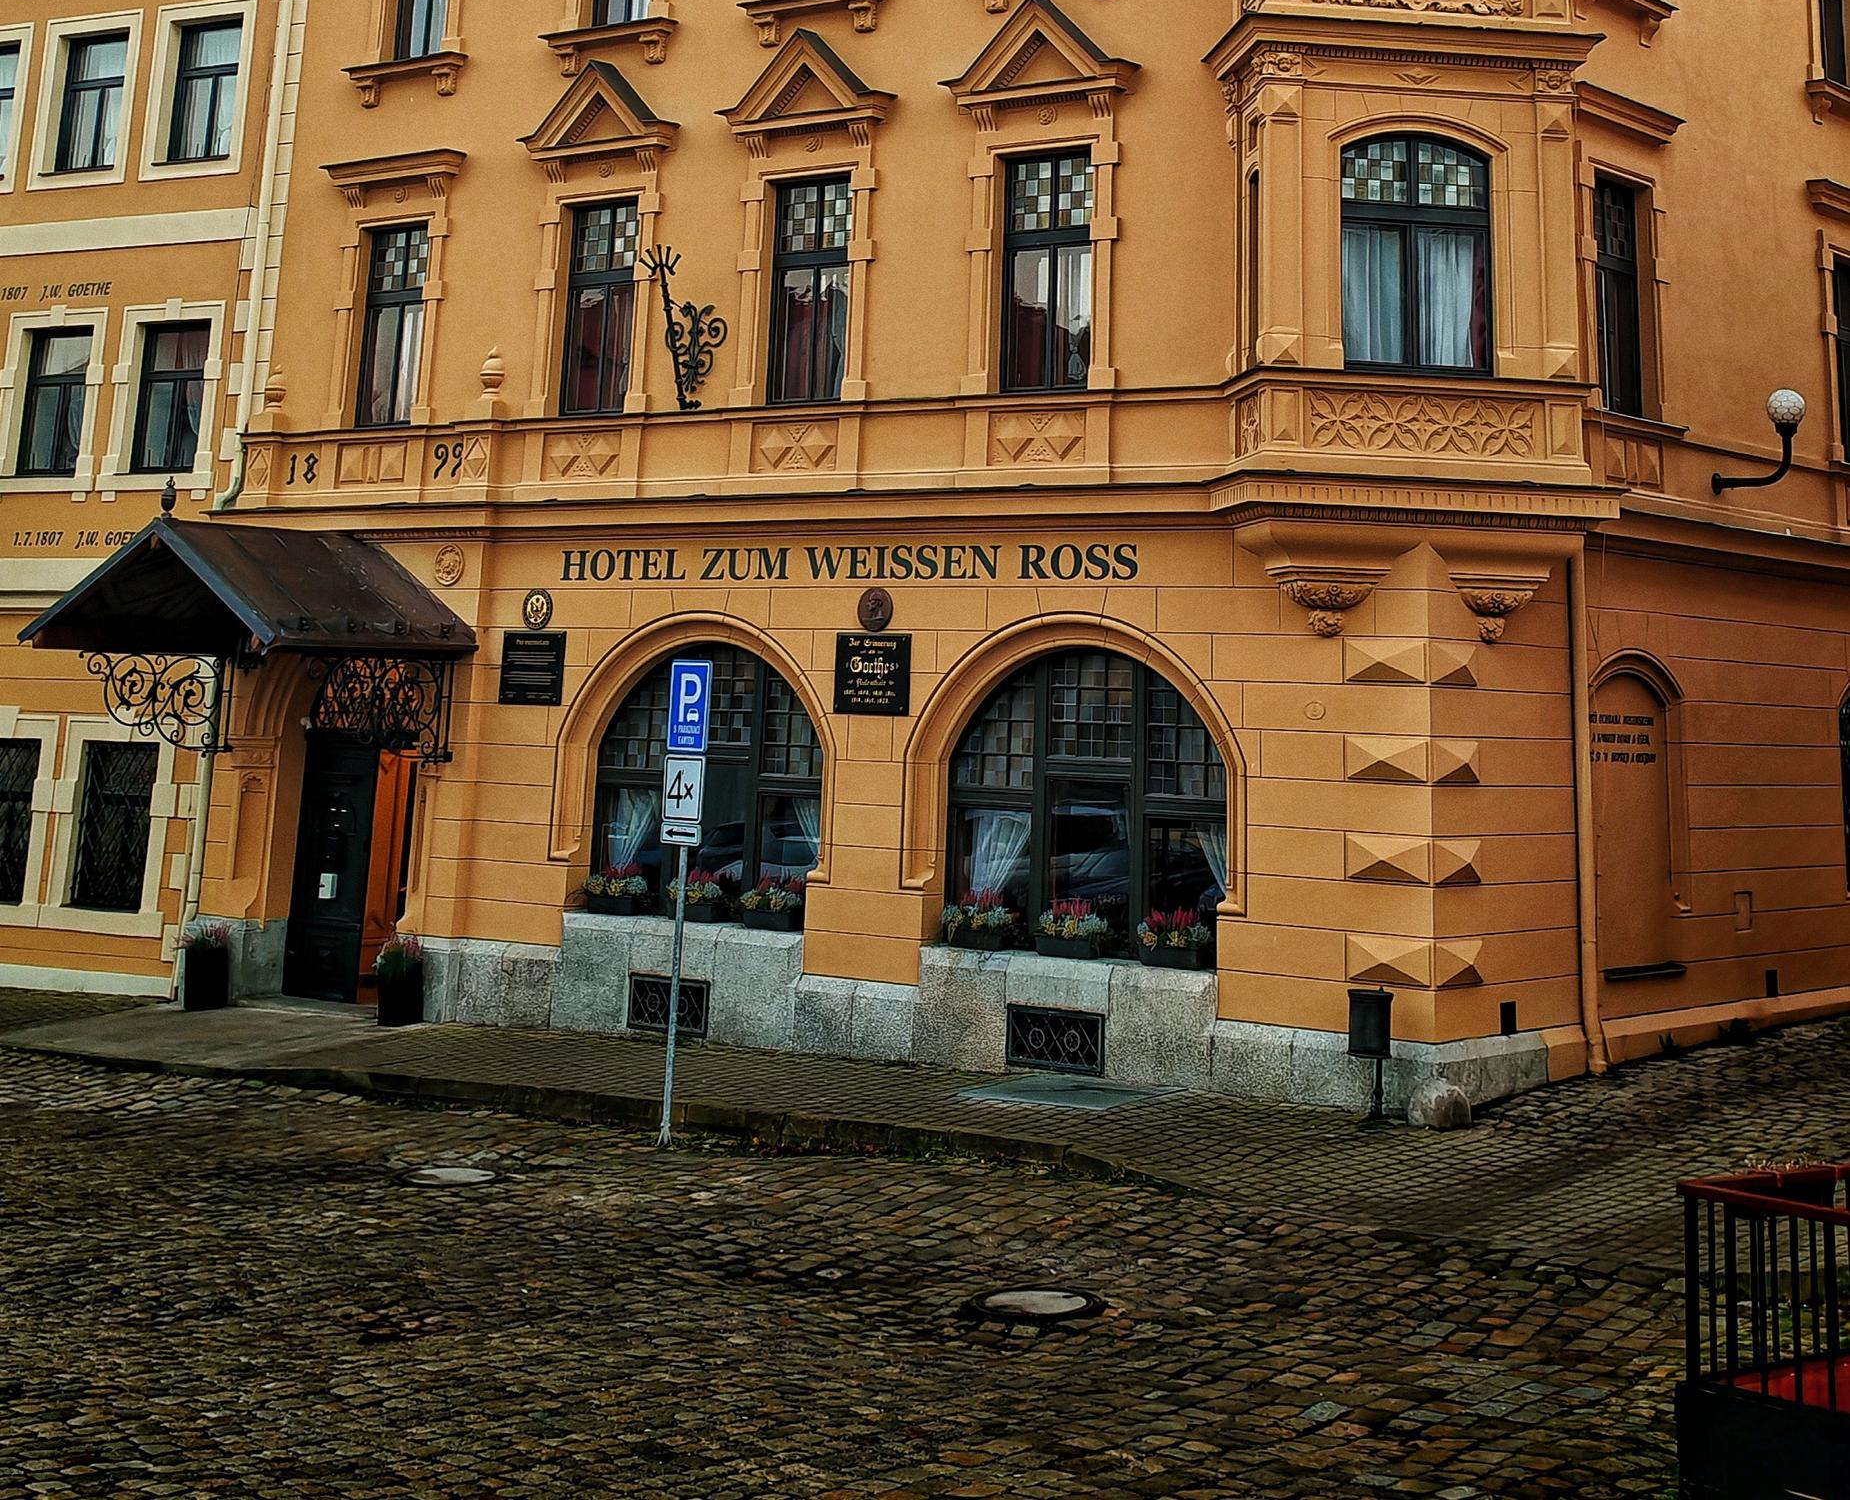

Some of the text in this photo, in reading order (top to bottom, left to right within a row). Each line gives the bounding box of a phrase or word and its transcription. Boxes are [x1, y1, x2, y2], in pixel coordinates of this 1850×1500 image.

[39, 284, 63, 302] J.W.
[67, 281, 113, 298] GOETHE
[13, 530, 138, 550] 1.7.1807 J.W. GOET
[559, 543, 1140, 582] HOTEL ZUM WEISSEN ROSS
[849, 656, 895, 679] Goethes
[678, 672, 702, 723] P
